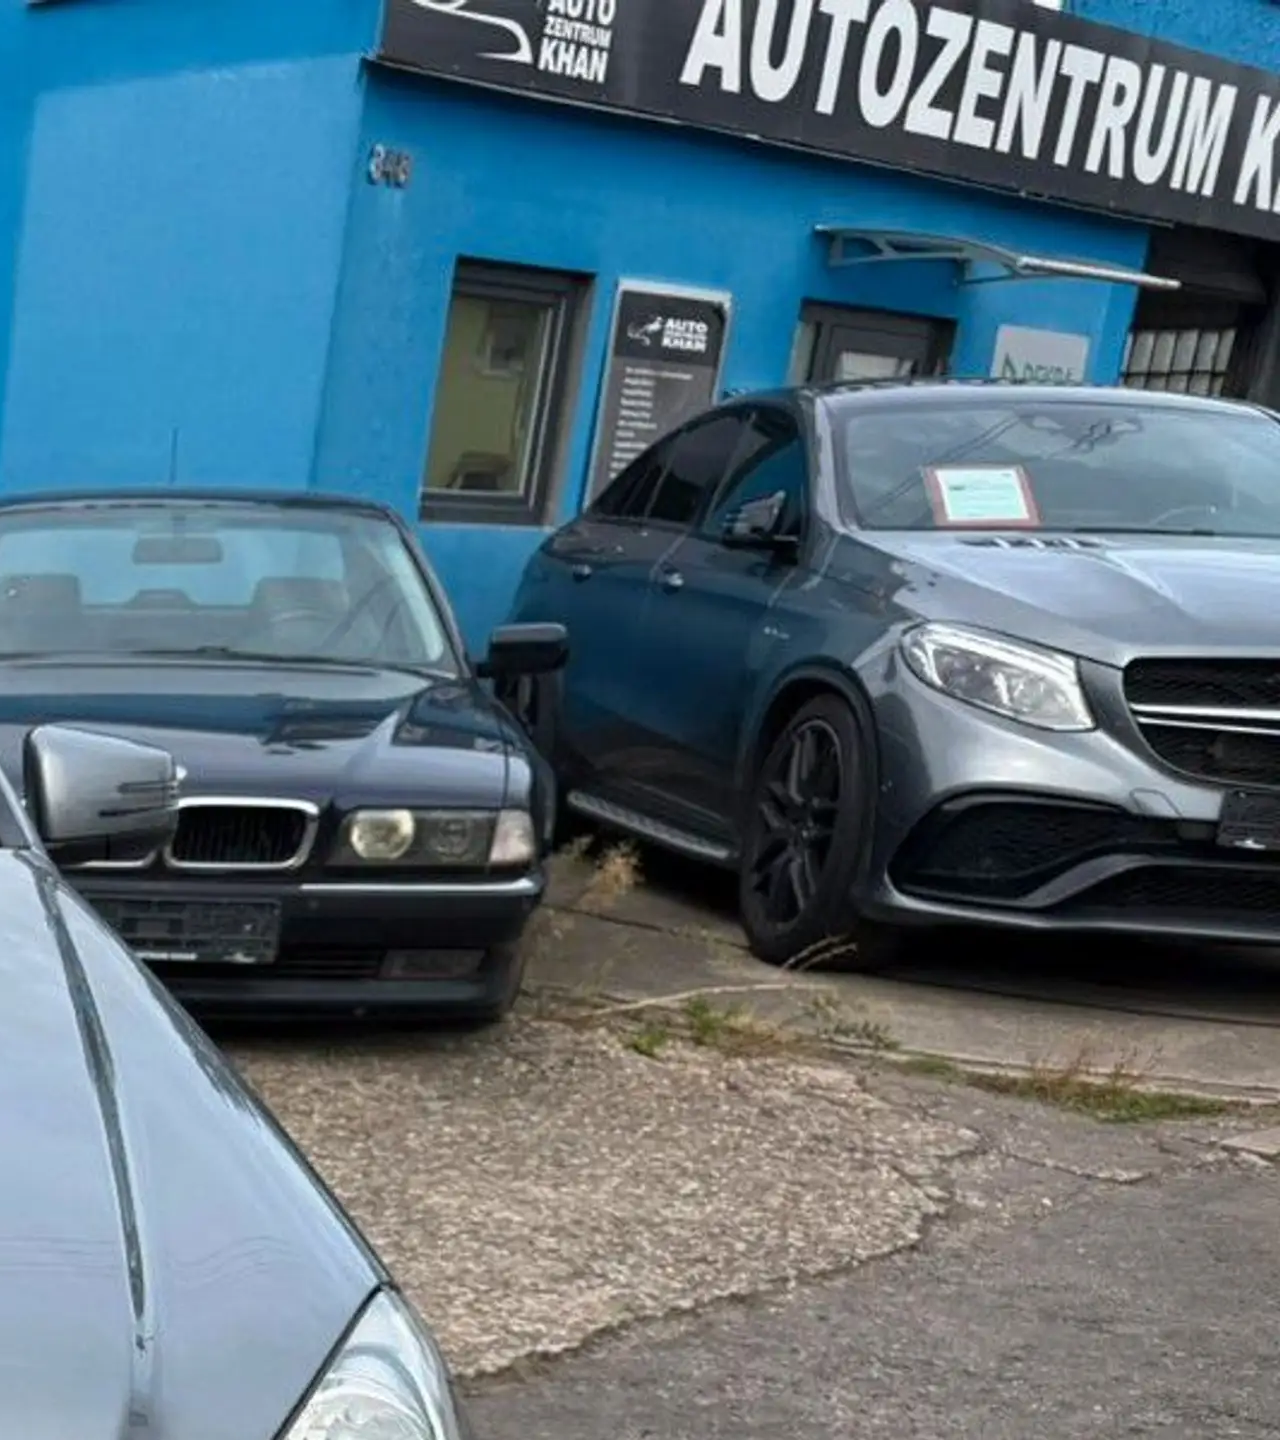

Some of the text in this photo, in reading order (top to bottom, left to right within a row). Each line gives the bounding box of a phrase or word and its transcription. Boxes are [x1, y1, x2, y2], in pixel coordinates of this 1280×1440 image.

[543, 14, 612, 49] ZENTRUM
[538, 36, 608, 84] KHAN
[679, 0, 1280, 215] AUTOZENTRUM K
[665, 318, 708, 333] AUTO
